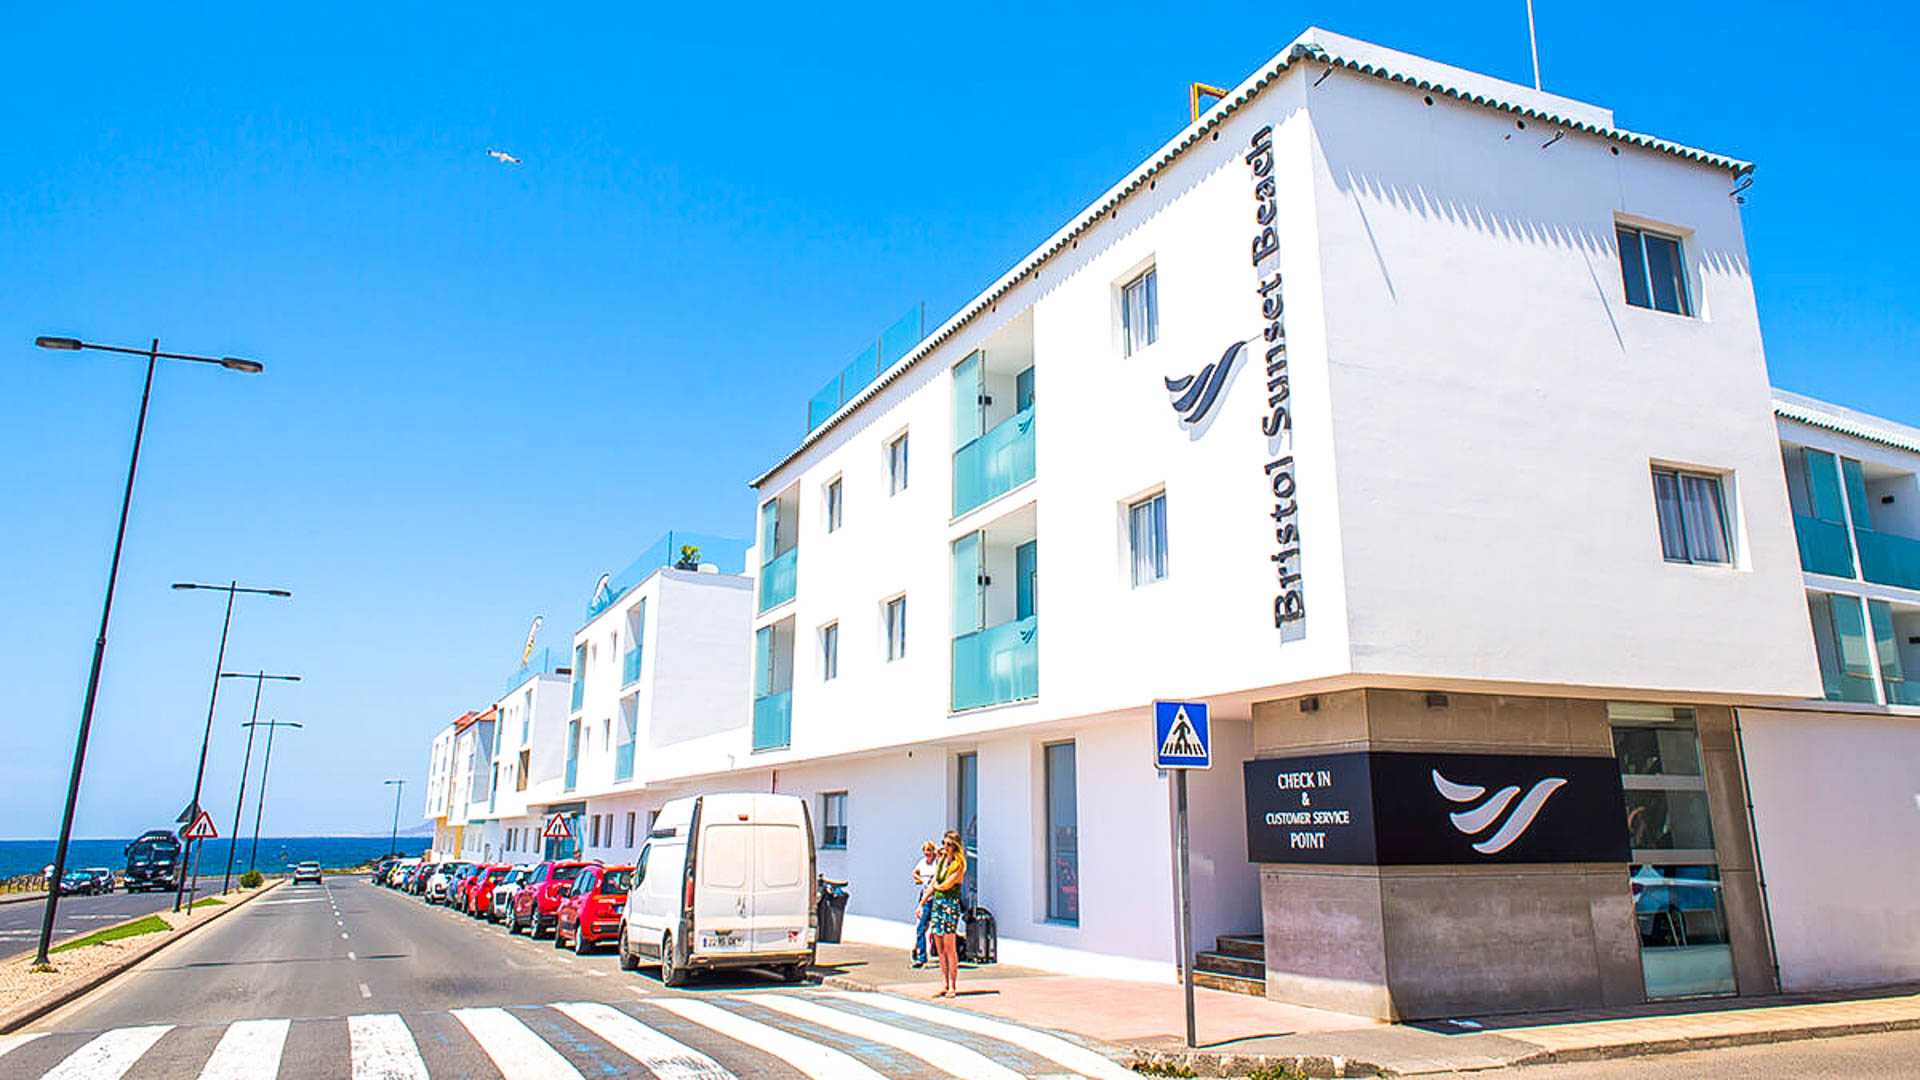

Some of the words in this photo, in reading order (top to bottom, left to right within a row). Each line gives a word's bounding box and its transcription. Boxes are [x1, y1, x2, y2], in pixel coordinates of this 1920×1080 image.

[1245, 125, 1281, 267] Beach
[1256, 272, 1292, 437] Sunset
[1264, 455, 1305, 629] Bristol
[1278, 772, 1316, 790] CHECK
[1317, 770, 1332, 787] IN
[1302, 791, 1311, 806] &
[1266, 812, 1312, 825] CUSTOMER
[1313, 810, 1350, 825] SERVICE
[1290, 832, 1326, 849] POINT
